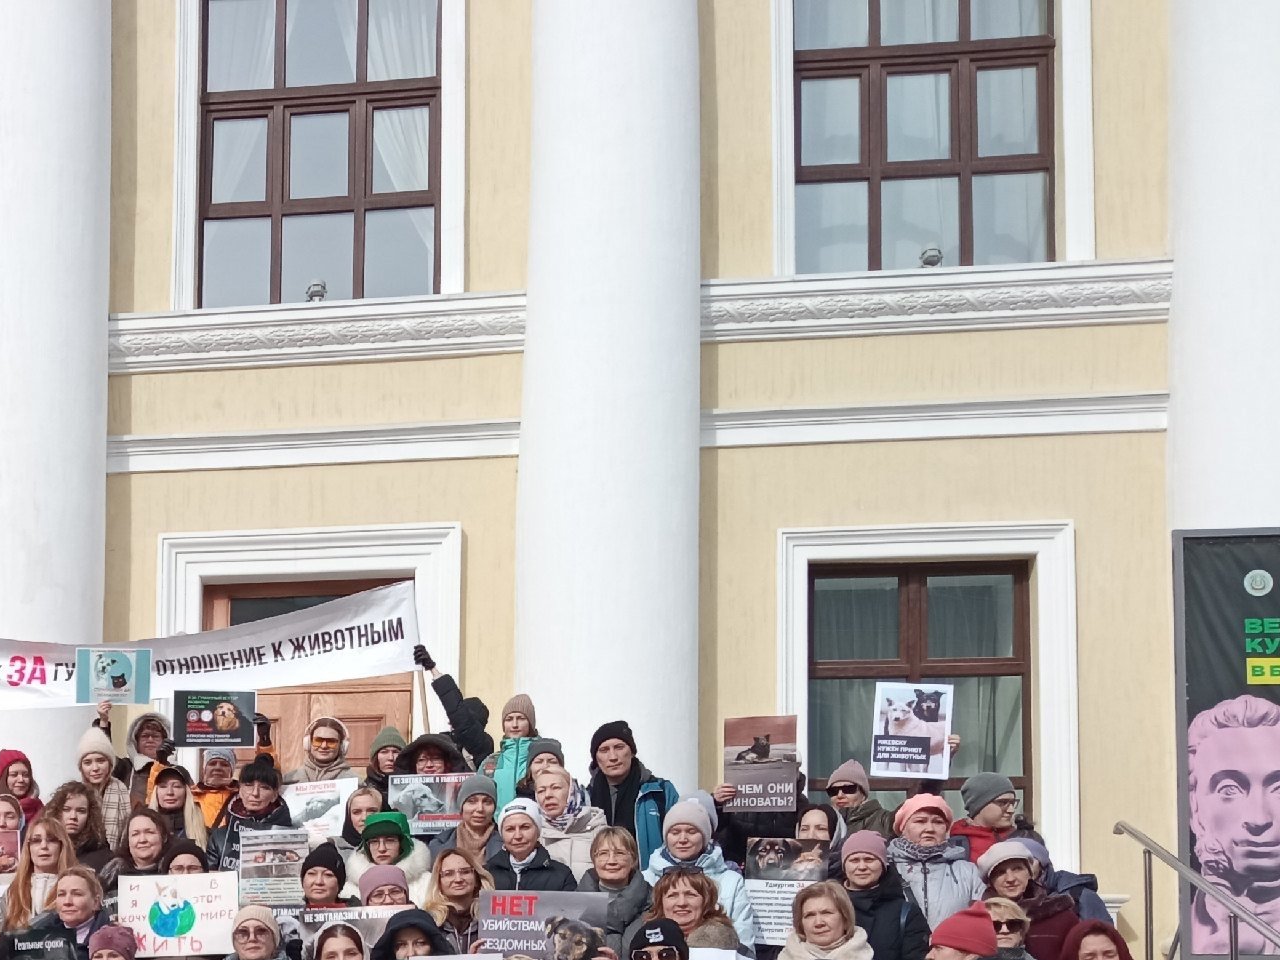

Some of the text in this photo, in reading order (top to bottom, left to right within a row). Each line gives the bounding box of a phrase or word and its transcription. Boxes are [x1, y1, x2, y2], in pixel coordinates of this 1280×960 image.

[1245, 618, 1280, 634] ВЕ
[6, 656, 46, 686] ЗА
[54, 662, 76, 682] ГУ
[156, 646, 268, 677] ОТНОШЕНИЕ
[272, 641, 285, 662] К
[288, 617, 404, 660] ЖИВОТНЫМ
[1246, 638, 1280, 654] КУ
[876, 752, 890, 760] ДЛЯ
[738, 782, 794, 794] ЧЕМ ОНИ
[130, 884, 140, 892] И
[210, 879, 218, 890] В
[132, 900, 138, 908] Я
[491, 896, 538, 916] НЕТ
[200, 910, 234, 920] МИРЕ
[304, 914, 314, 922] НЕ
[482, 918, 545, 932] УБИЙСТВАМ
[14, 938, 44, 951] Реальные
